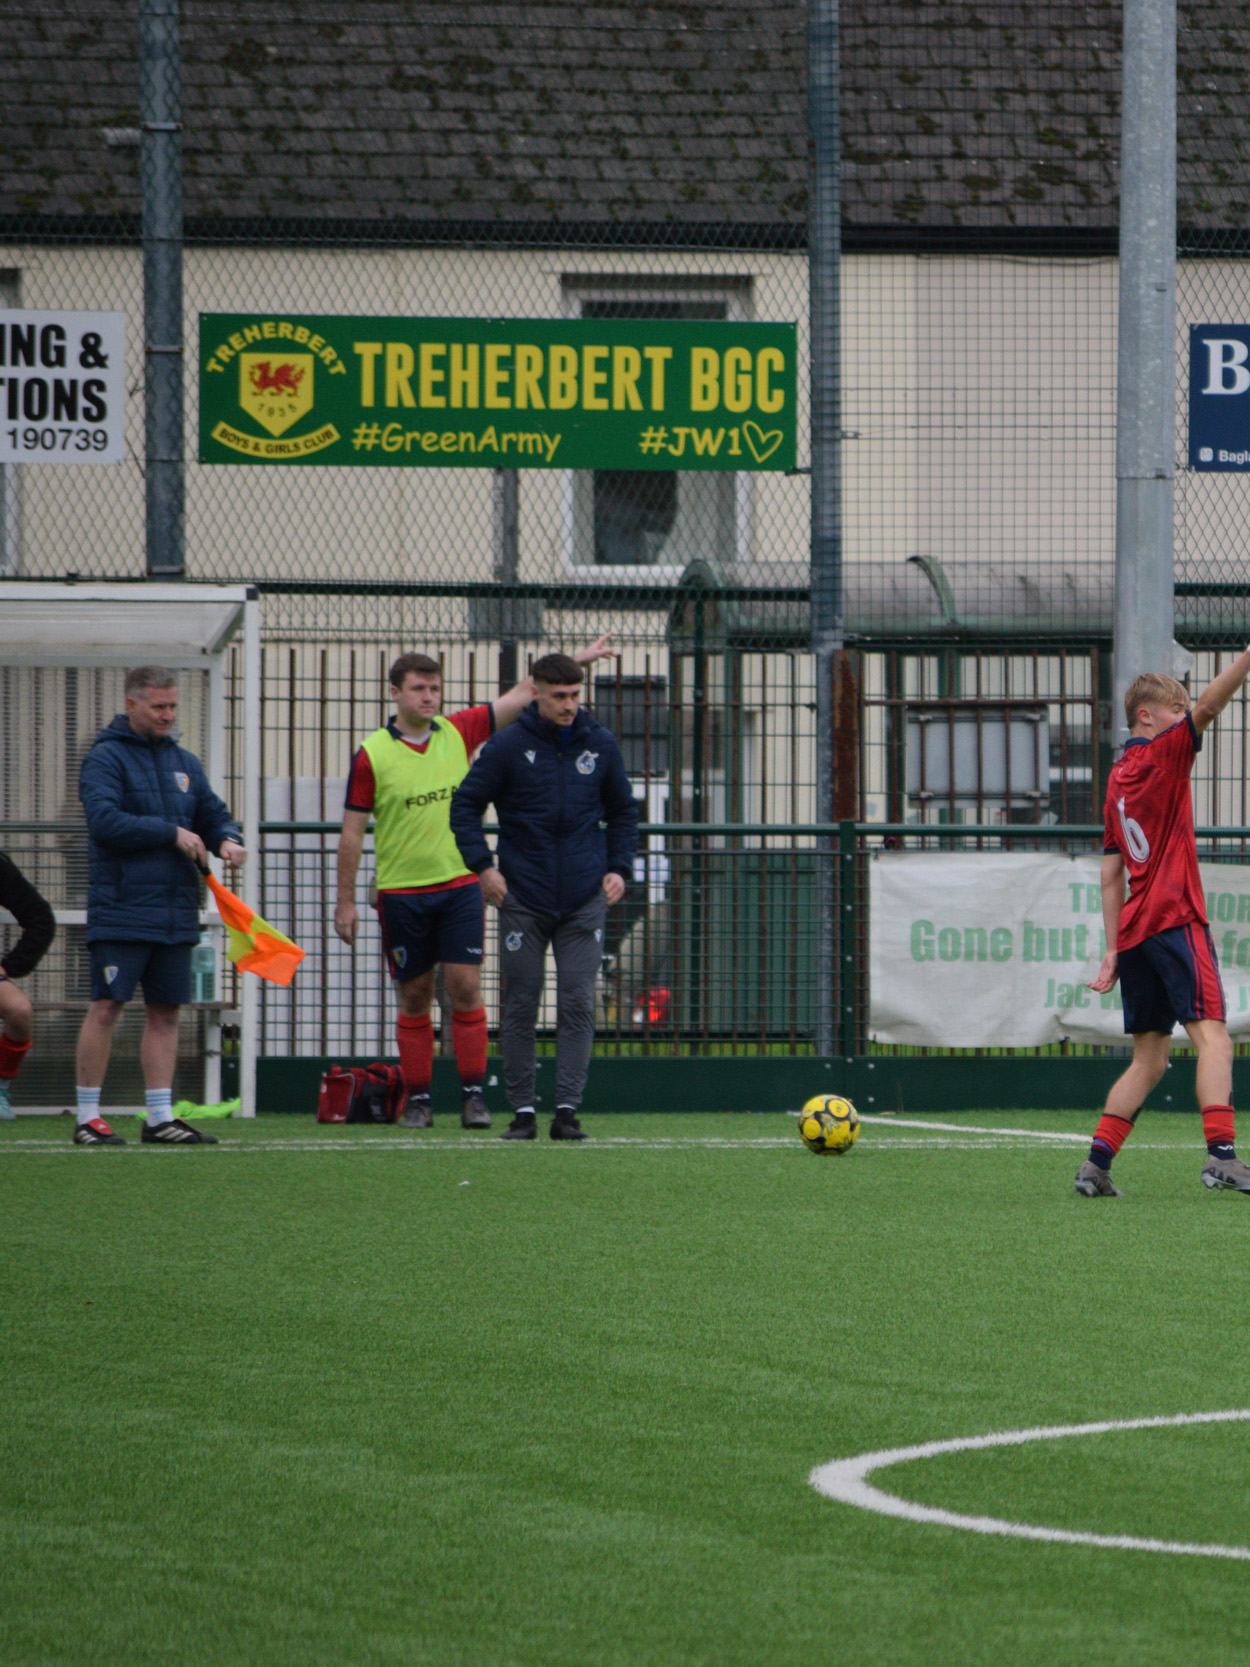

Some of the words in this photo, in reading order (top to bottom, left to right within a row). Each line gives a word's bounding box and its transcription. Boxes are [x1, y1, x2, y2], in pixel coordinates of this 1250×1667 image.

[79, 332, 109, 369] &
[206, 322, 347, 373] TREHERBERT
[353, 341, 673, 412] TREHERBERT
[690, 346, 785, 414] BGC
[0, 377, 107, 423] IONS
[7, 427, 108, 451] 190739
[218, 427, 249, 449] BOYS
[252, 440, 262, 452] &
[265, 442, 302, 455] GIRLS
[304, 429, 335, 450] CLUB
[352, 422, 562, 463] #GreenArmy
[910, 919, 1013, 962] Gone
[1023, 920, 1090, 962] but
[1044, 978, 1091, 1009] Jac
